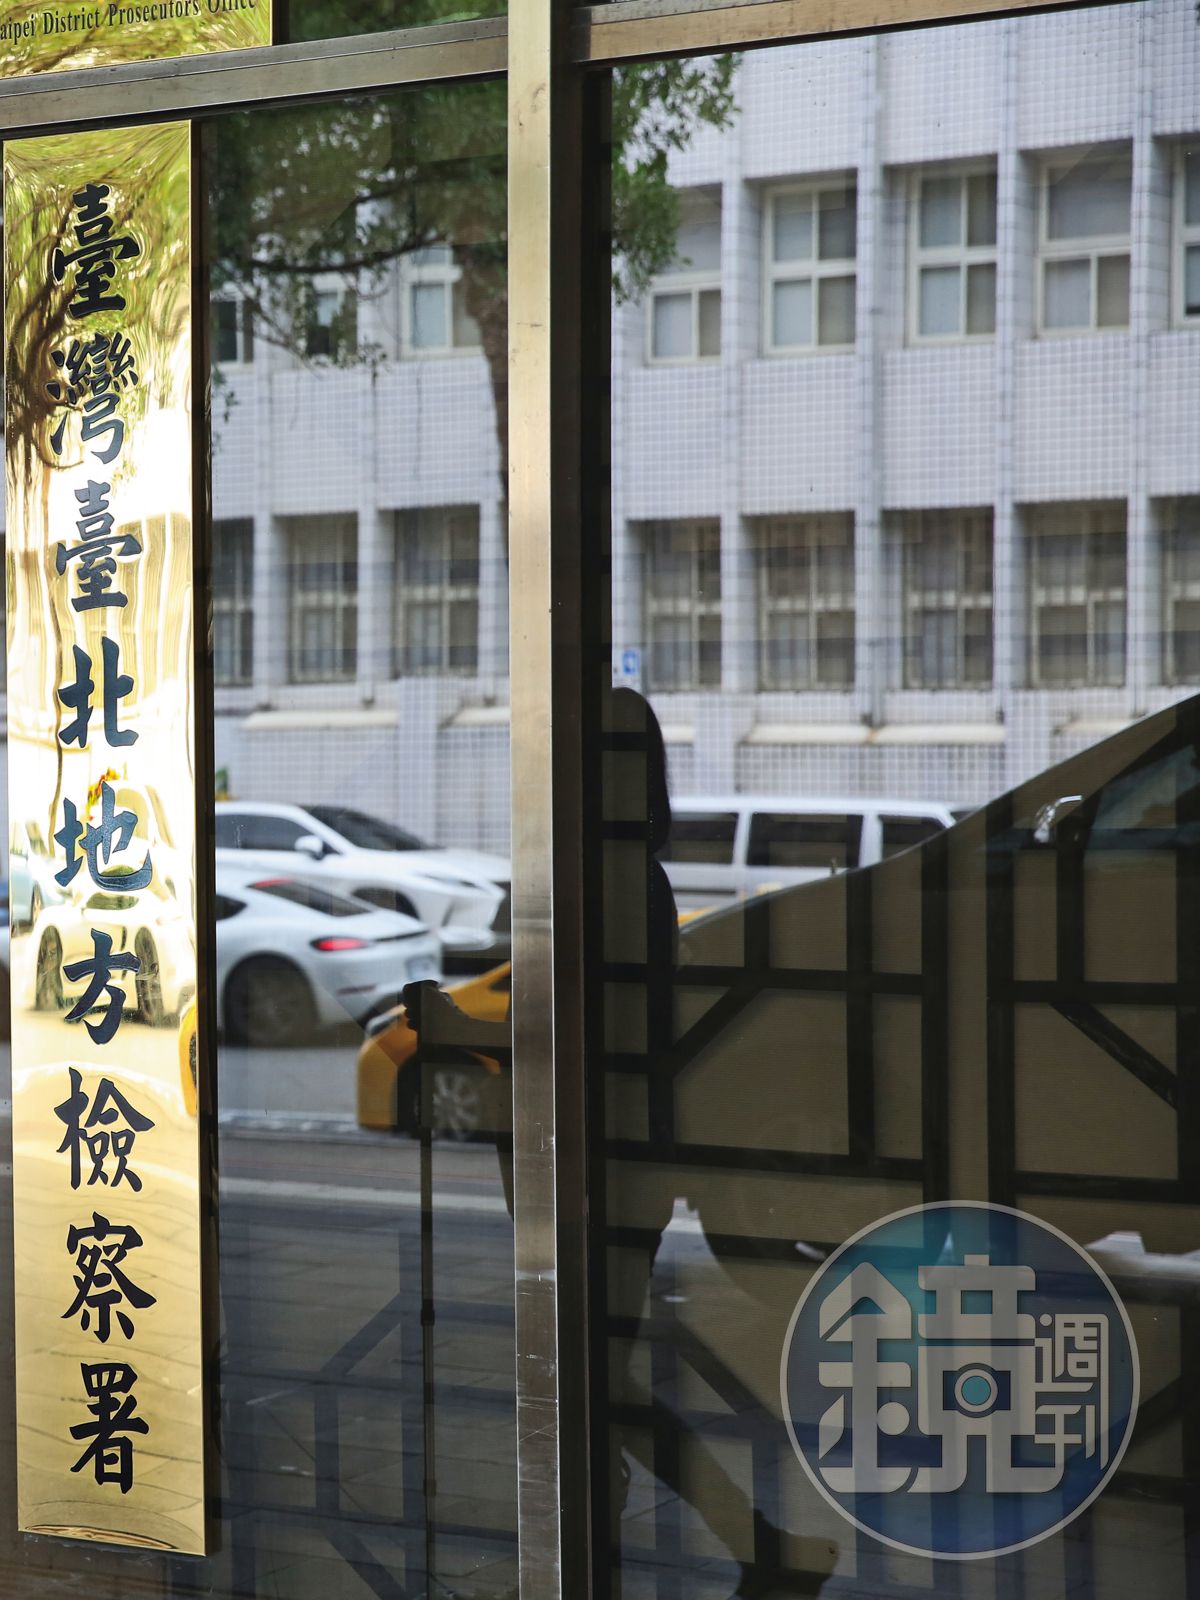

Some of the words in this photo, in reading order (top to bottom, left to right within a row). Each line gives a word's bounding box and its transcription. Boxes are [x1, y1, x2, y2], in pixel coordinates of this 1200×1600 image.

[43, 7, 100, 35] District
[108, 0, 199, 27] Prosecutors
[44, 183, 158, 1495] 臺灣臺北地方檢察署
